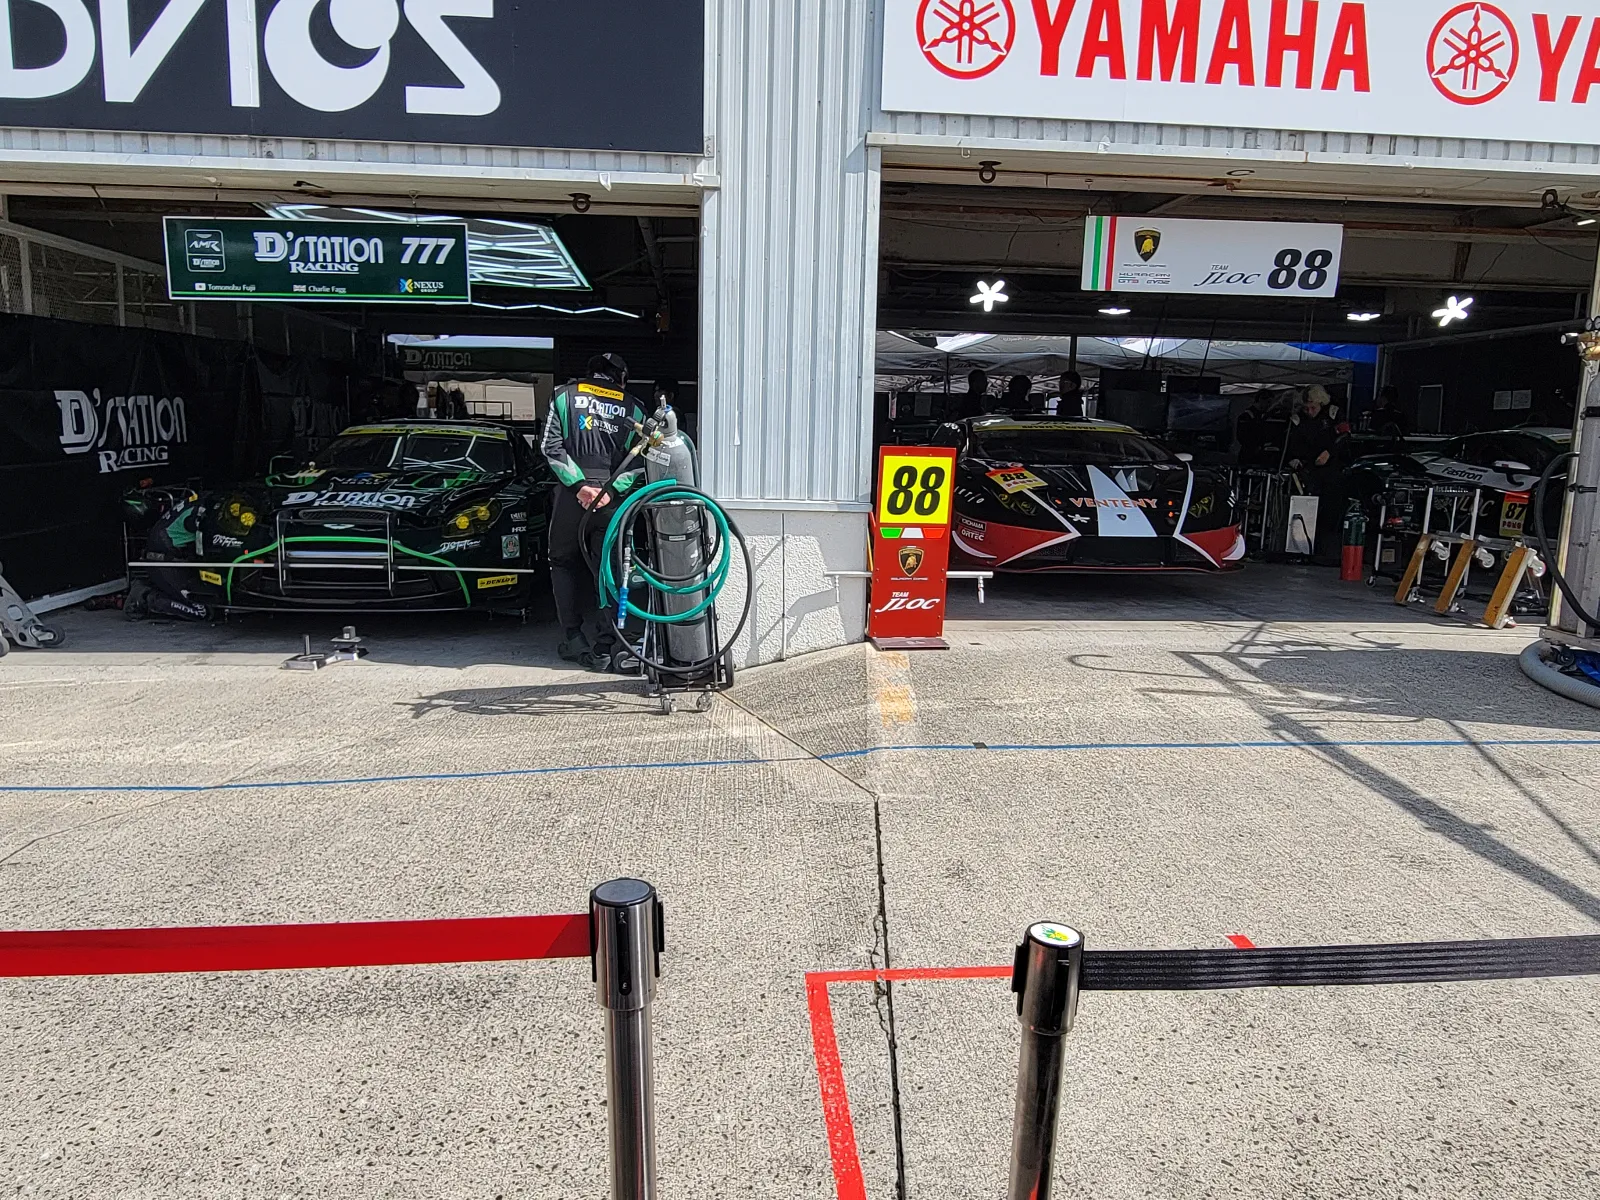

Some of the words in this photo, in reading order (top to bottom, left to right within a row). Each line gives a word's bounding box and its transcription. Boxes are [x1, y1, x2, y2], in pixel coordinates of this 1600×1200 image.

[1031, 0, 1371, 92] YAMAHA
[400, 237, 456, 265] 777
[290, 262, 360, 273] RACING
[1267, 248, 1333, 290] 88
[413, 281, 444, 290] NEXUS
[1193, 271, 1261, 286] JLOC
[308, 285, 330, 293] Charlie
[330, 286, 347, 294] Fagg
[98, 445, 169, 473] RACING
[999, 471, 1028, 482] 88
[1441, 467, 1484, 482] Fastron
[886, 465, 946, 516] 88
[1068, 497, 1158, 509] VENTENY
[1504, 502, 1528, 520] 87
[874, 598, 941, 613] JLOC
